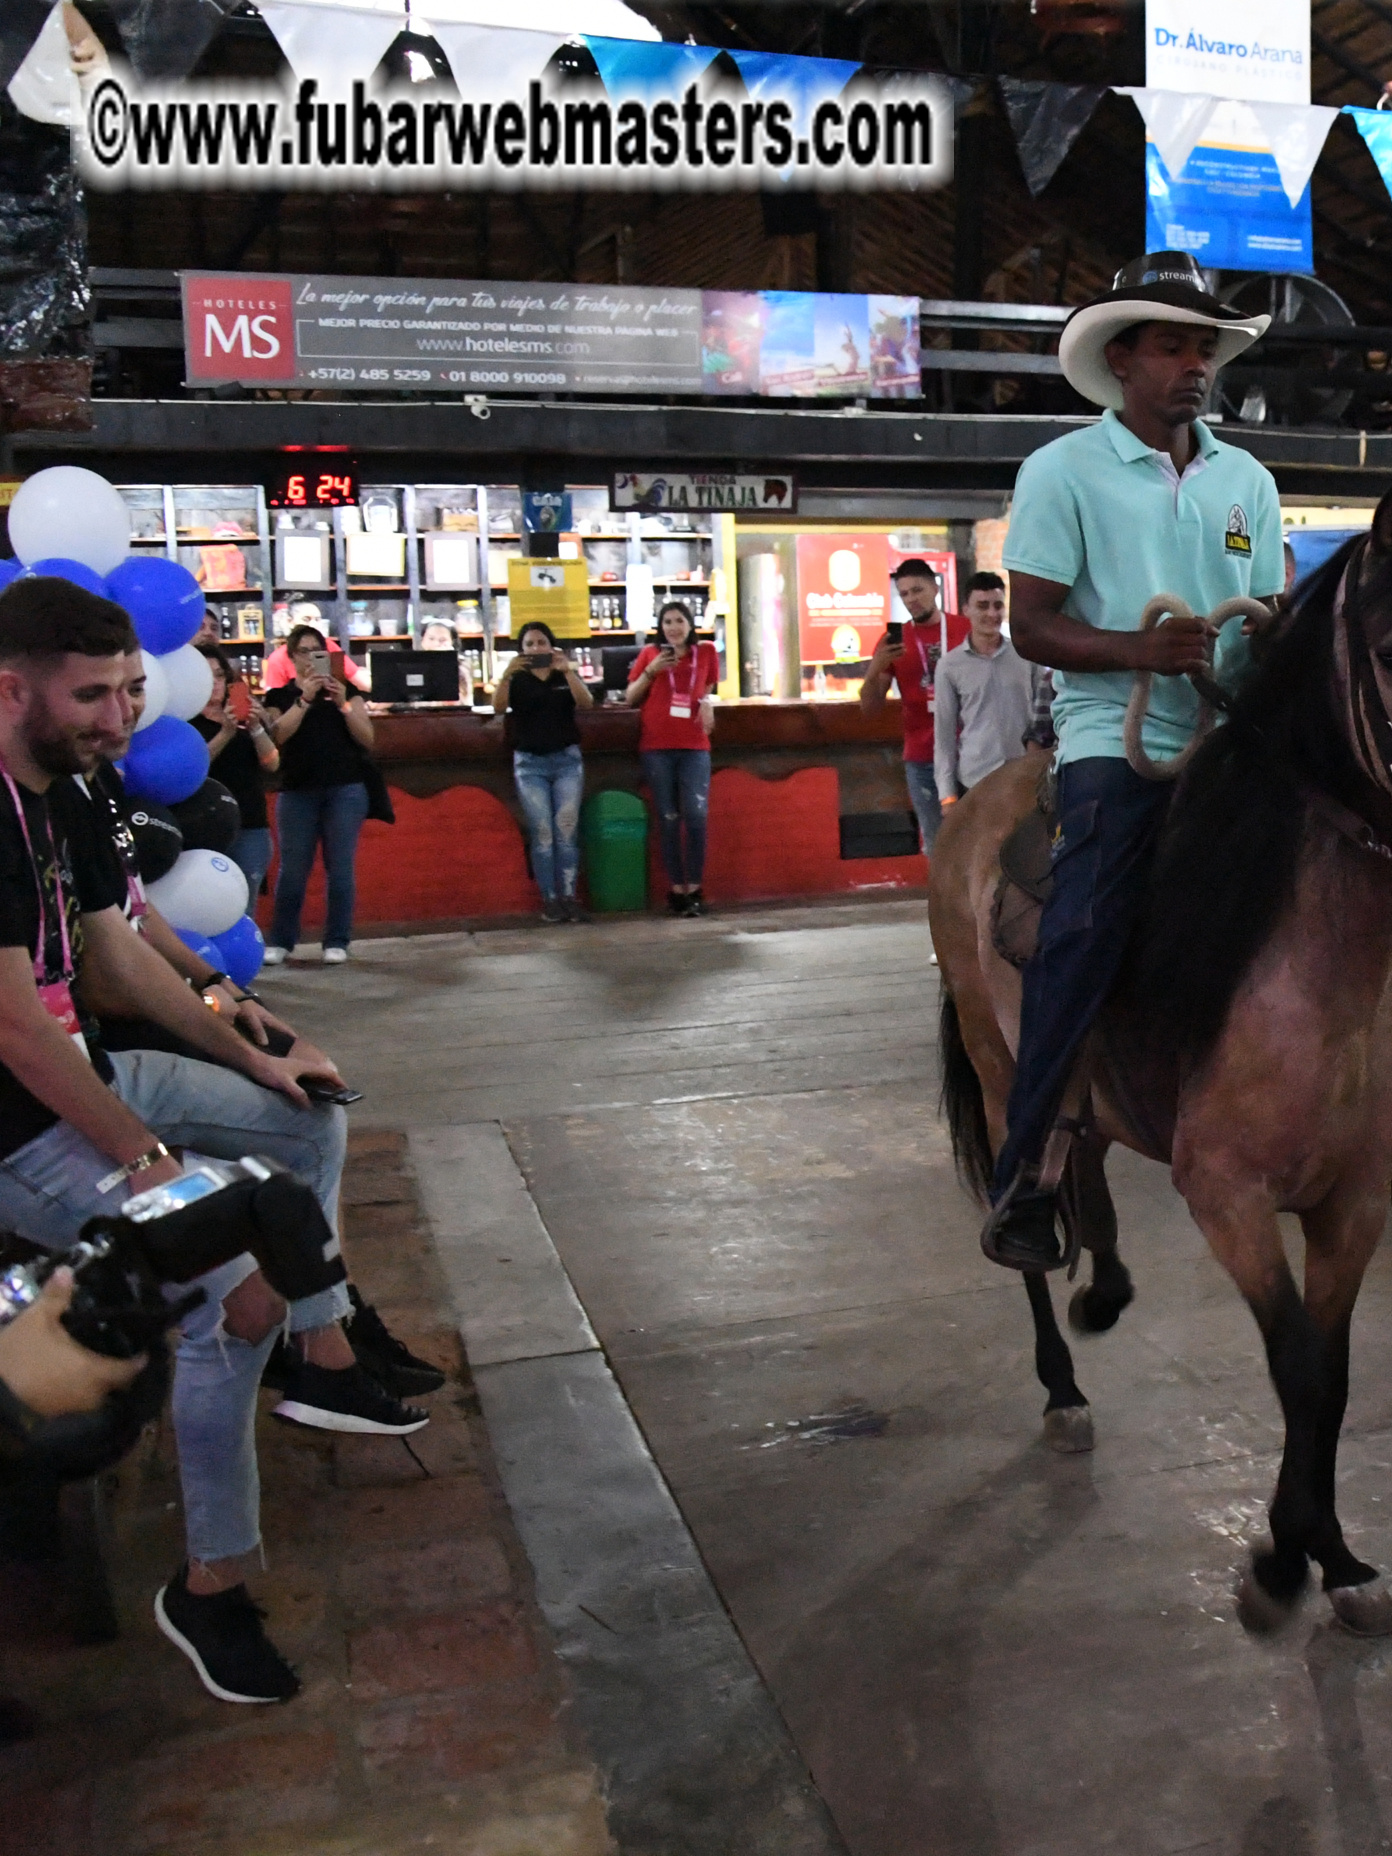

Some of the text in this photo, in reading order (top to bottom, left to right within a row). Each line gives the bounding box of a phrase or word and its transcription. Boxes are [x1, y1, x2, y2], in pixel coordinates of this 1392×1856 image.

[1154, 27, 1303, 65] Dr. Álvaro Arana
[203, 298, 277, 310] HOTELES
[296, 282, 698, 322] La mejor opción para tus viajes de trabajo o placer
[204, 314, 281, 359] MS
[318, 317, 356, 328] MEJOR
[359, 318, 400, 329] PRECIO
[403, 320, 480, 332] GARANTIZADO
[483, 323, 506, 332] POR
[509, 323, 544, 333] MEDIO
[546, 324, 562, 335] DE
[564, 325, 612, 336] NUESTRA
[655, 327, 678, 338] WEB
[416, 336, 591, 355] www.hotelesms.com
[308, 368, 432, 382] +57(2) 485 5259
[450, 371, 567, 385] 01 8000 910098
[668, 485, 758, 508] LA TINAJA
